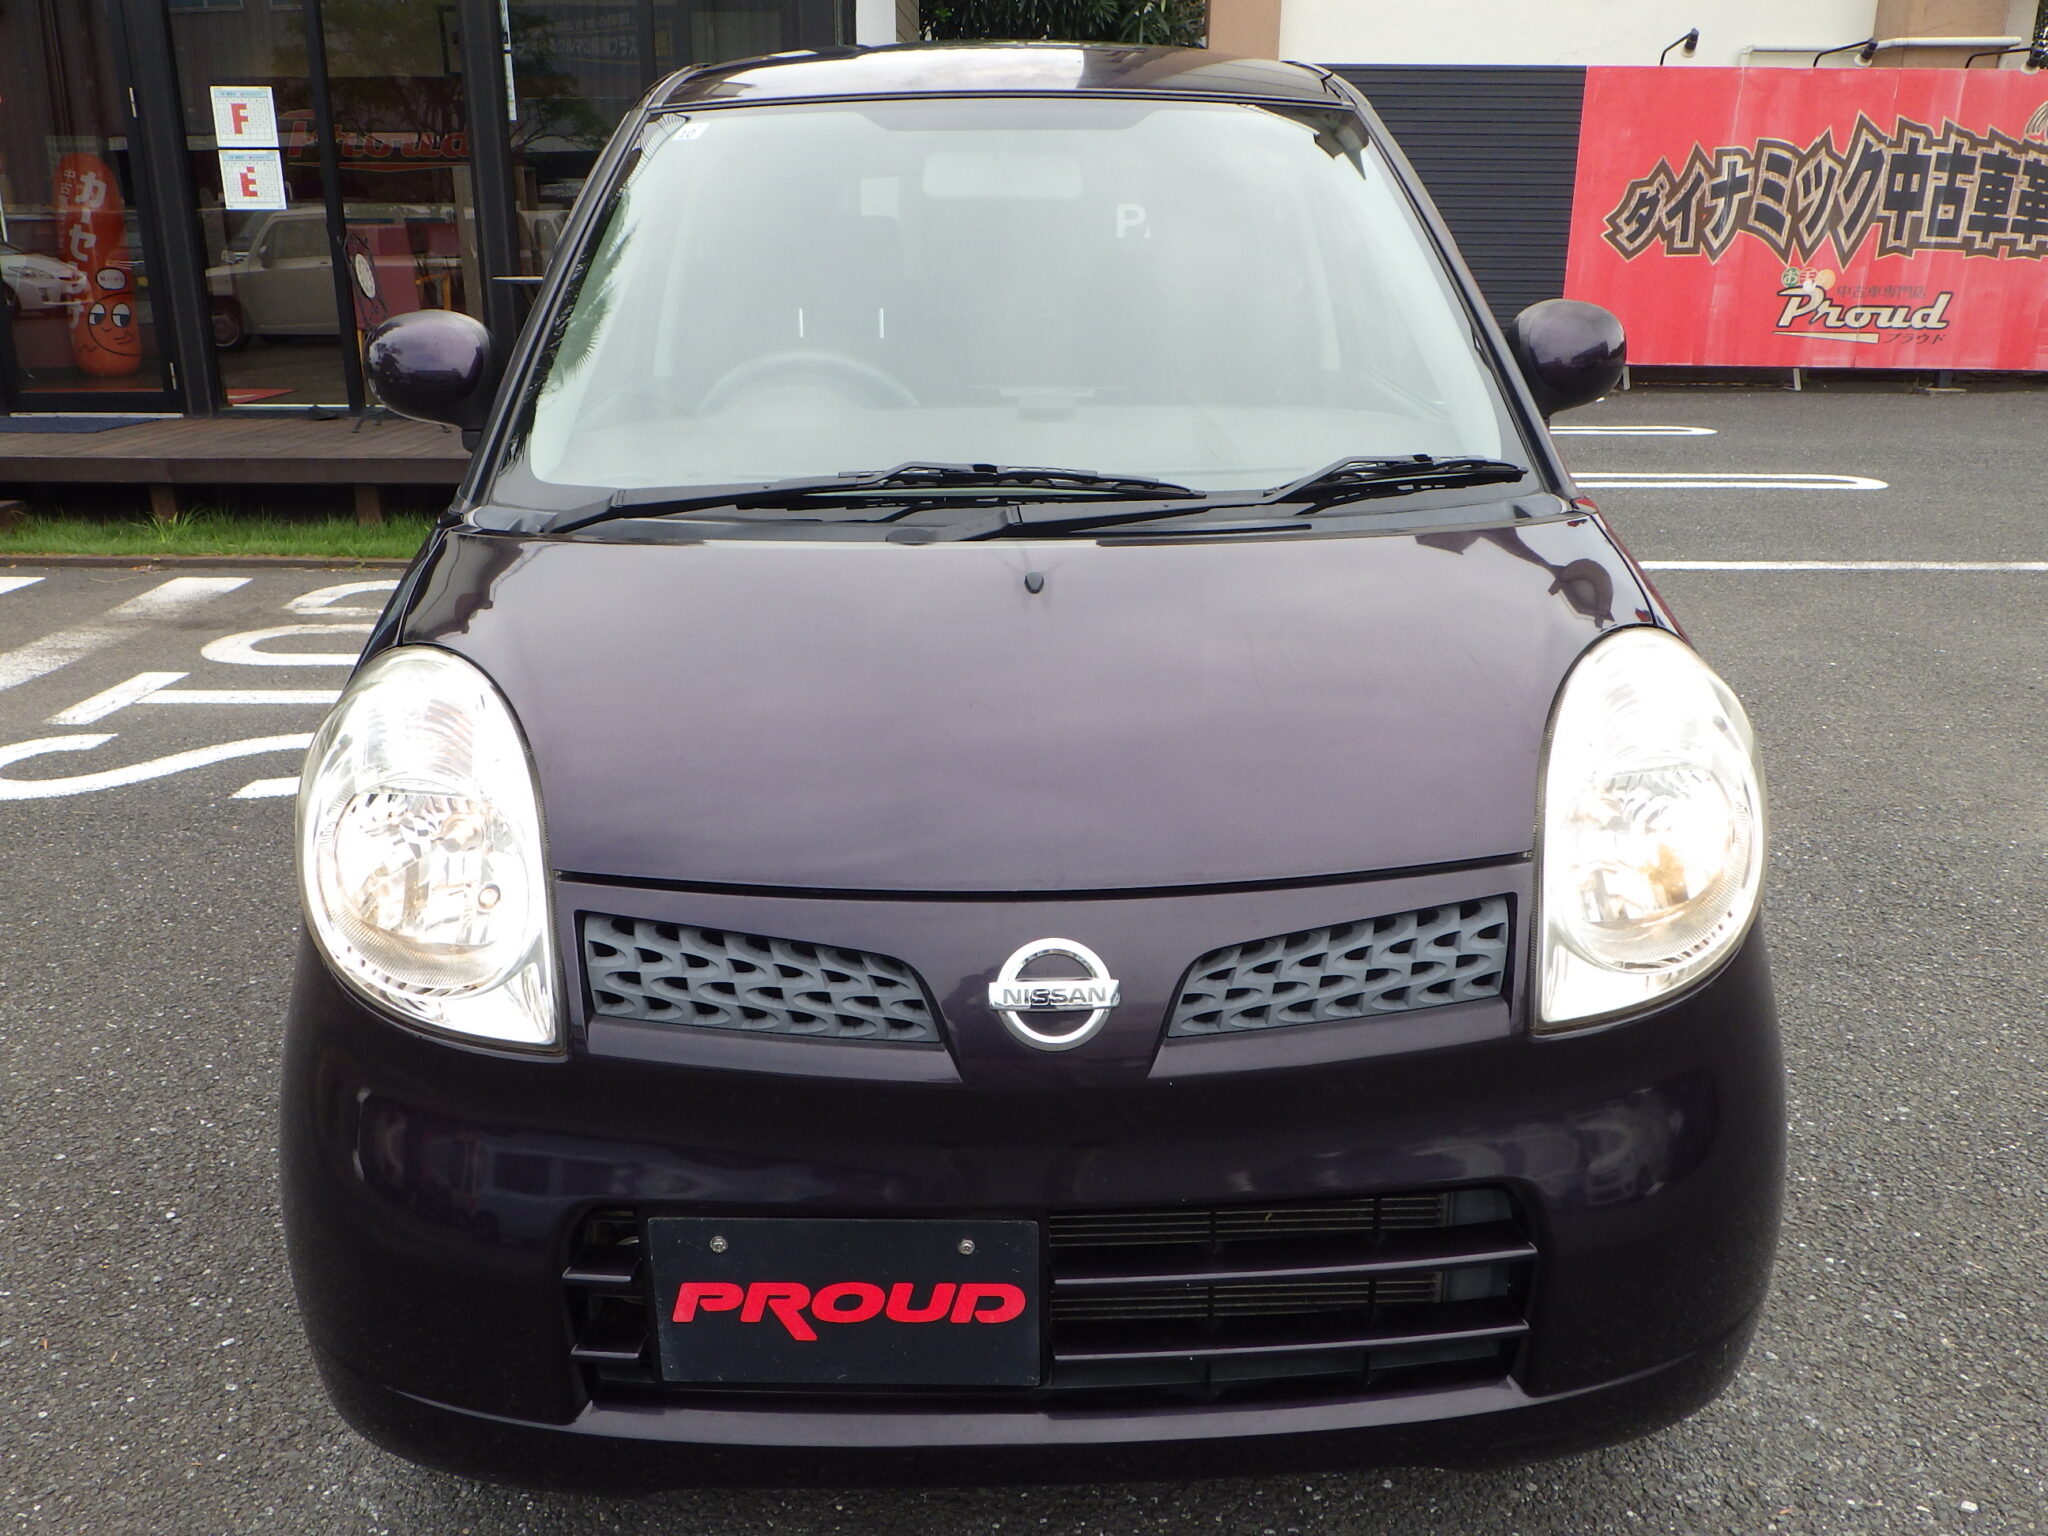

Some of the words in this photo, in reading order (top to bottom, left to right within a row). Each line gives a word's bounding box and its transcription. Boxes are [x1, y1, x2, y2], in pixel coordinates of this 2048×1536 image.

[1776, 285, 1953, 329] Proud
[1002, 986, 1107, 1006] NISSAN
[672, 1281, 1027, 1342] PROUD
